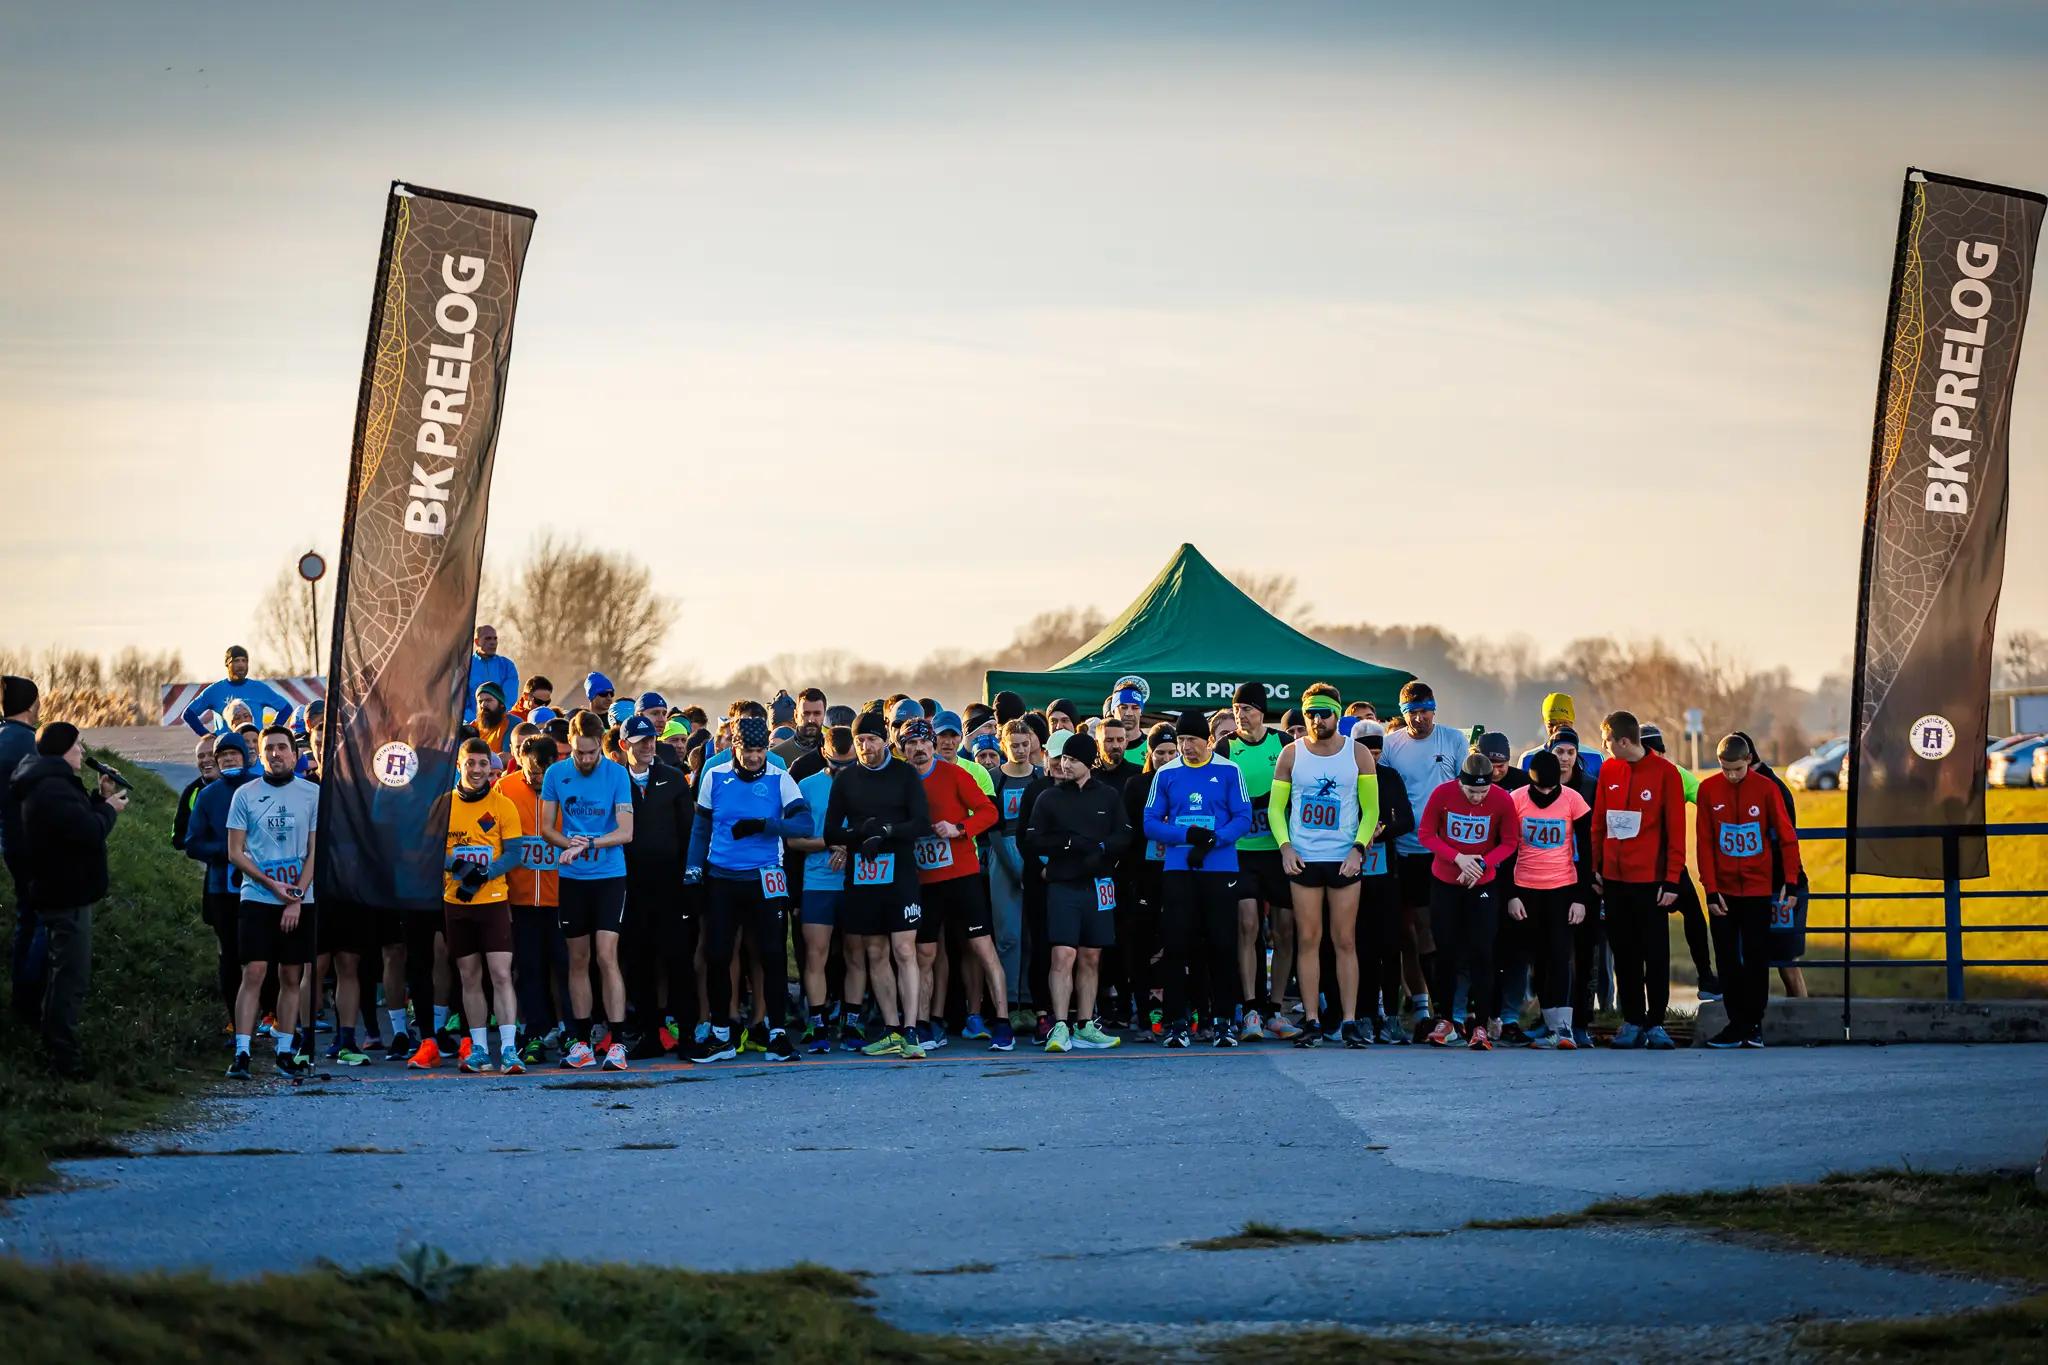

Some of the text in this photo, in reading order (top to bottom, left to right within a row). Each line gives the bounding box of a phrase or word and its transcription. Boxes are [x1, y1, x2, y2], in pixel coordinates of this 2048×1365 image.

[1925, 240, 1999, 514] BK PRELOG
[404, 253, 485, 535] BK PRELOG
[1171, 682, 1290, 699] BK PROG
[267, 818, 286, 828] K15
[1302, 803, 1337, 827] 690
[1451, 821, 1486, 840] 679
[1526, 826, 1561, 844] 740
[916, 841, 949, 865] 382
[1724, 832, 1759, 853] 593
[521, 844, 555, 865] 793
[264, 865, 299, 886] 509
[857, 860, 889, 881] 397
